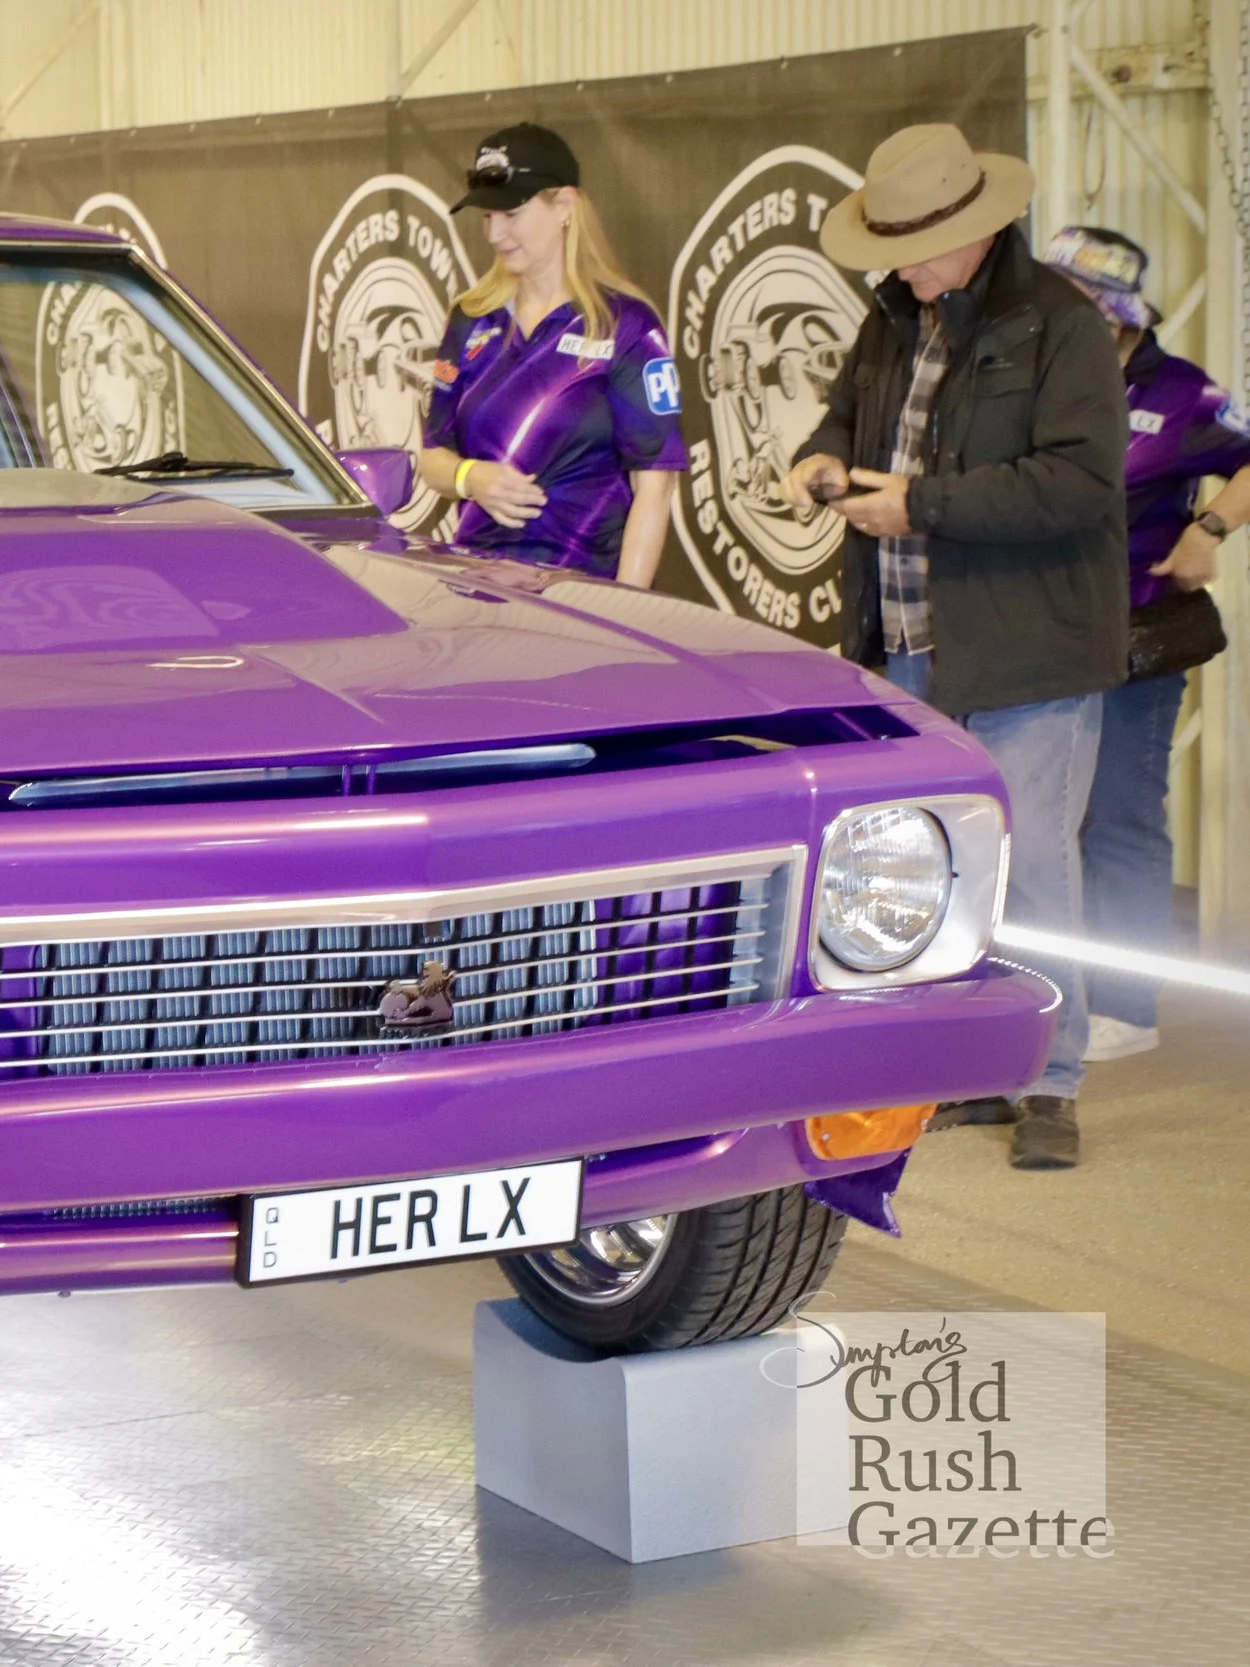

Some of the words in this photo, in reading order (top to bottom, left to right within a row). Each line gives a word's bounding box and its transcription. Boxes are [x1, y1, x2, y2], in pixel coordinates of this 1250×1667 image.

[316, 210, 400, 352] CHARTERS
[683, 188, 797, 359] CHARTERS
[689, 439, 802, 629] RESTORERS
[330, 1189, 438, 1260] HER
[460, 1177, 531, 1243] LX
